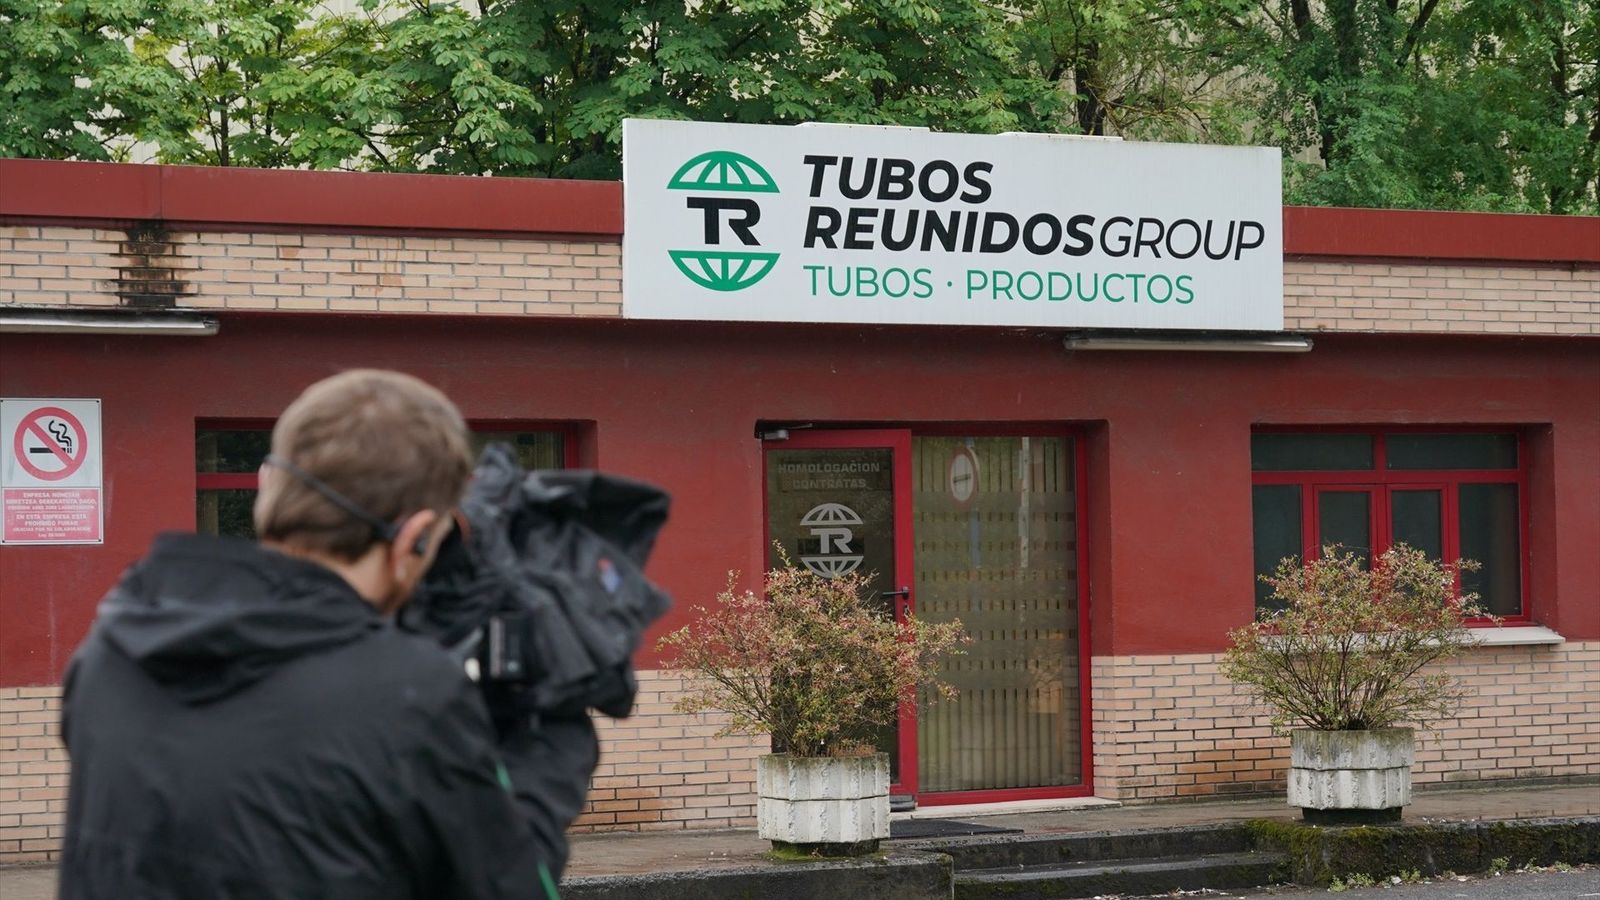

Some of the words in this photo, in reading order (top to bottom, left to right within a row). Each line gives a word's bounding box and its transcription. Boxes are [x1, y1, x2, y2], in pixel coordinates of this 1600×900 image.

[803, 155, 994, 204] TUBOS
[686, 197, 761, 246] TR
[803, 265, 933, 299] TUBOS
[966, 270, 1195, 305] PRODUCTOS
[793, 478, 867, 489] CONTRATAS
[810, 527, 853, 554] TR
